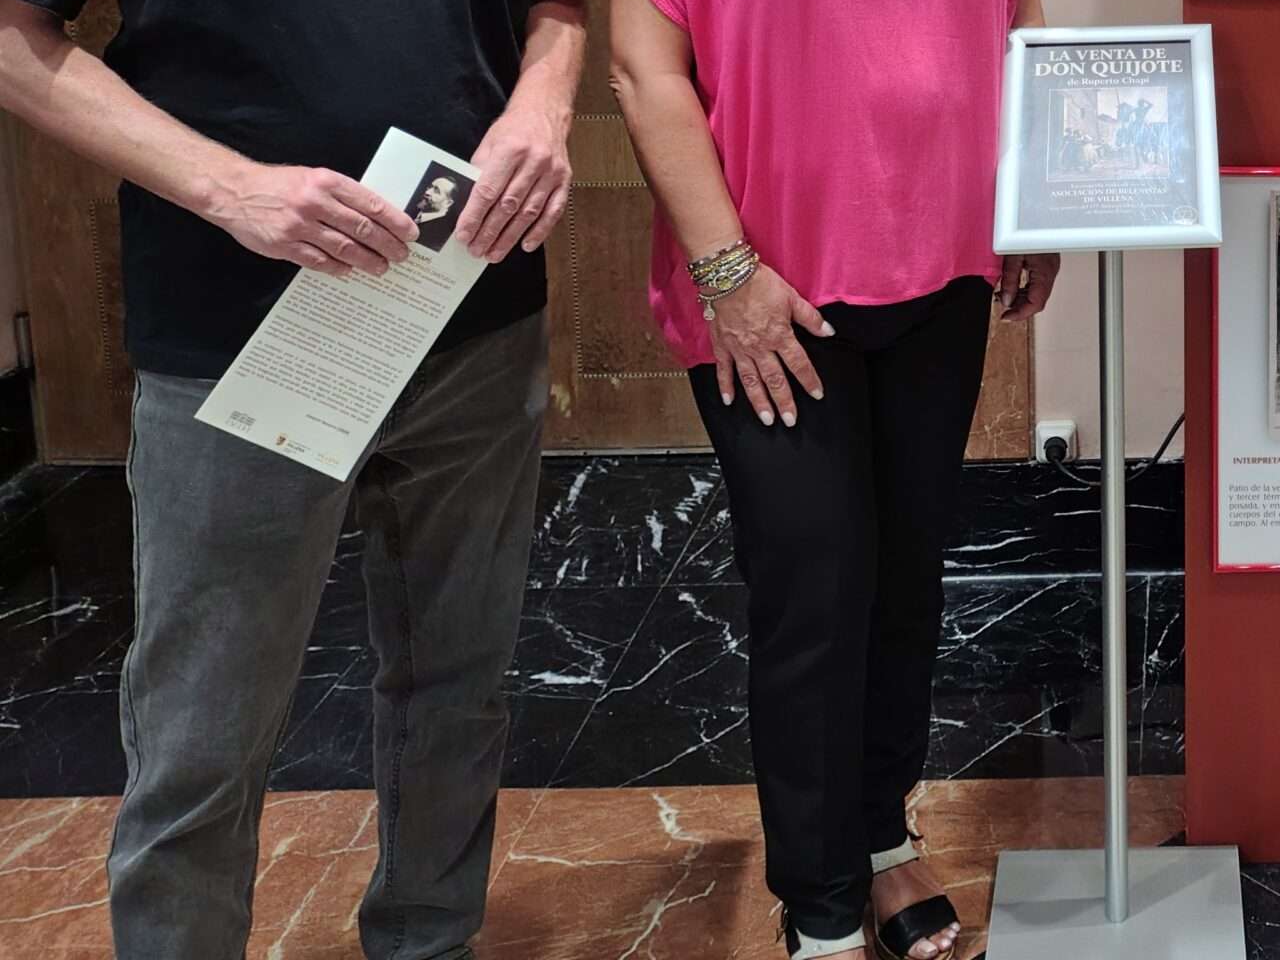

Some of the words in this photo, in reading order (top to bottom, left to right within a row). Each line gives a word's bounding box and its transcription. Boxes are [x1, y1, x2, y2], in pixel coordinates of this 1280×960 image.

[1050, 50, 1070, 62] LA
[1076, 49, 1136, 61] VENTA
[1142, 48, 1166, 59] DE
[1034, 62, 1084, 76] DON
[1091, 60, 1184, 77] QUIJOTE
[1067, 78, 1080, 86] de
[1082, 78, 1119, 87] Ruperto
